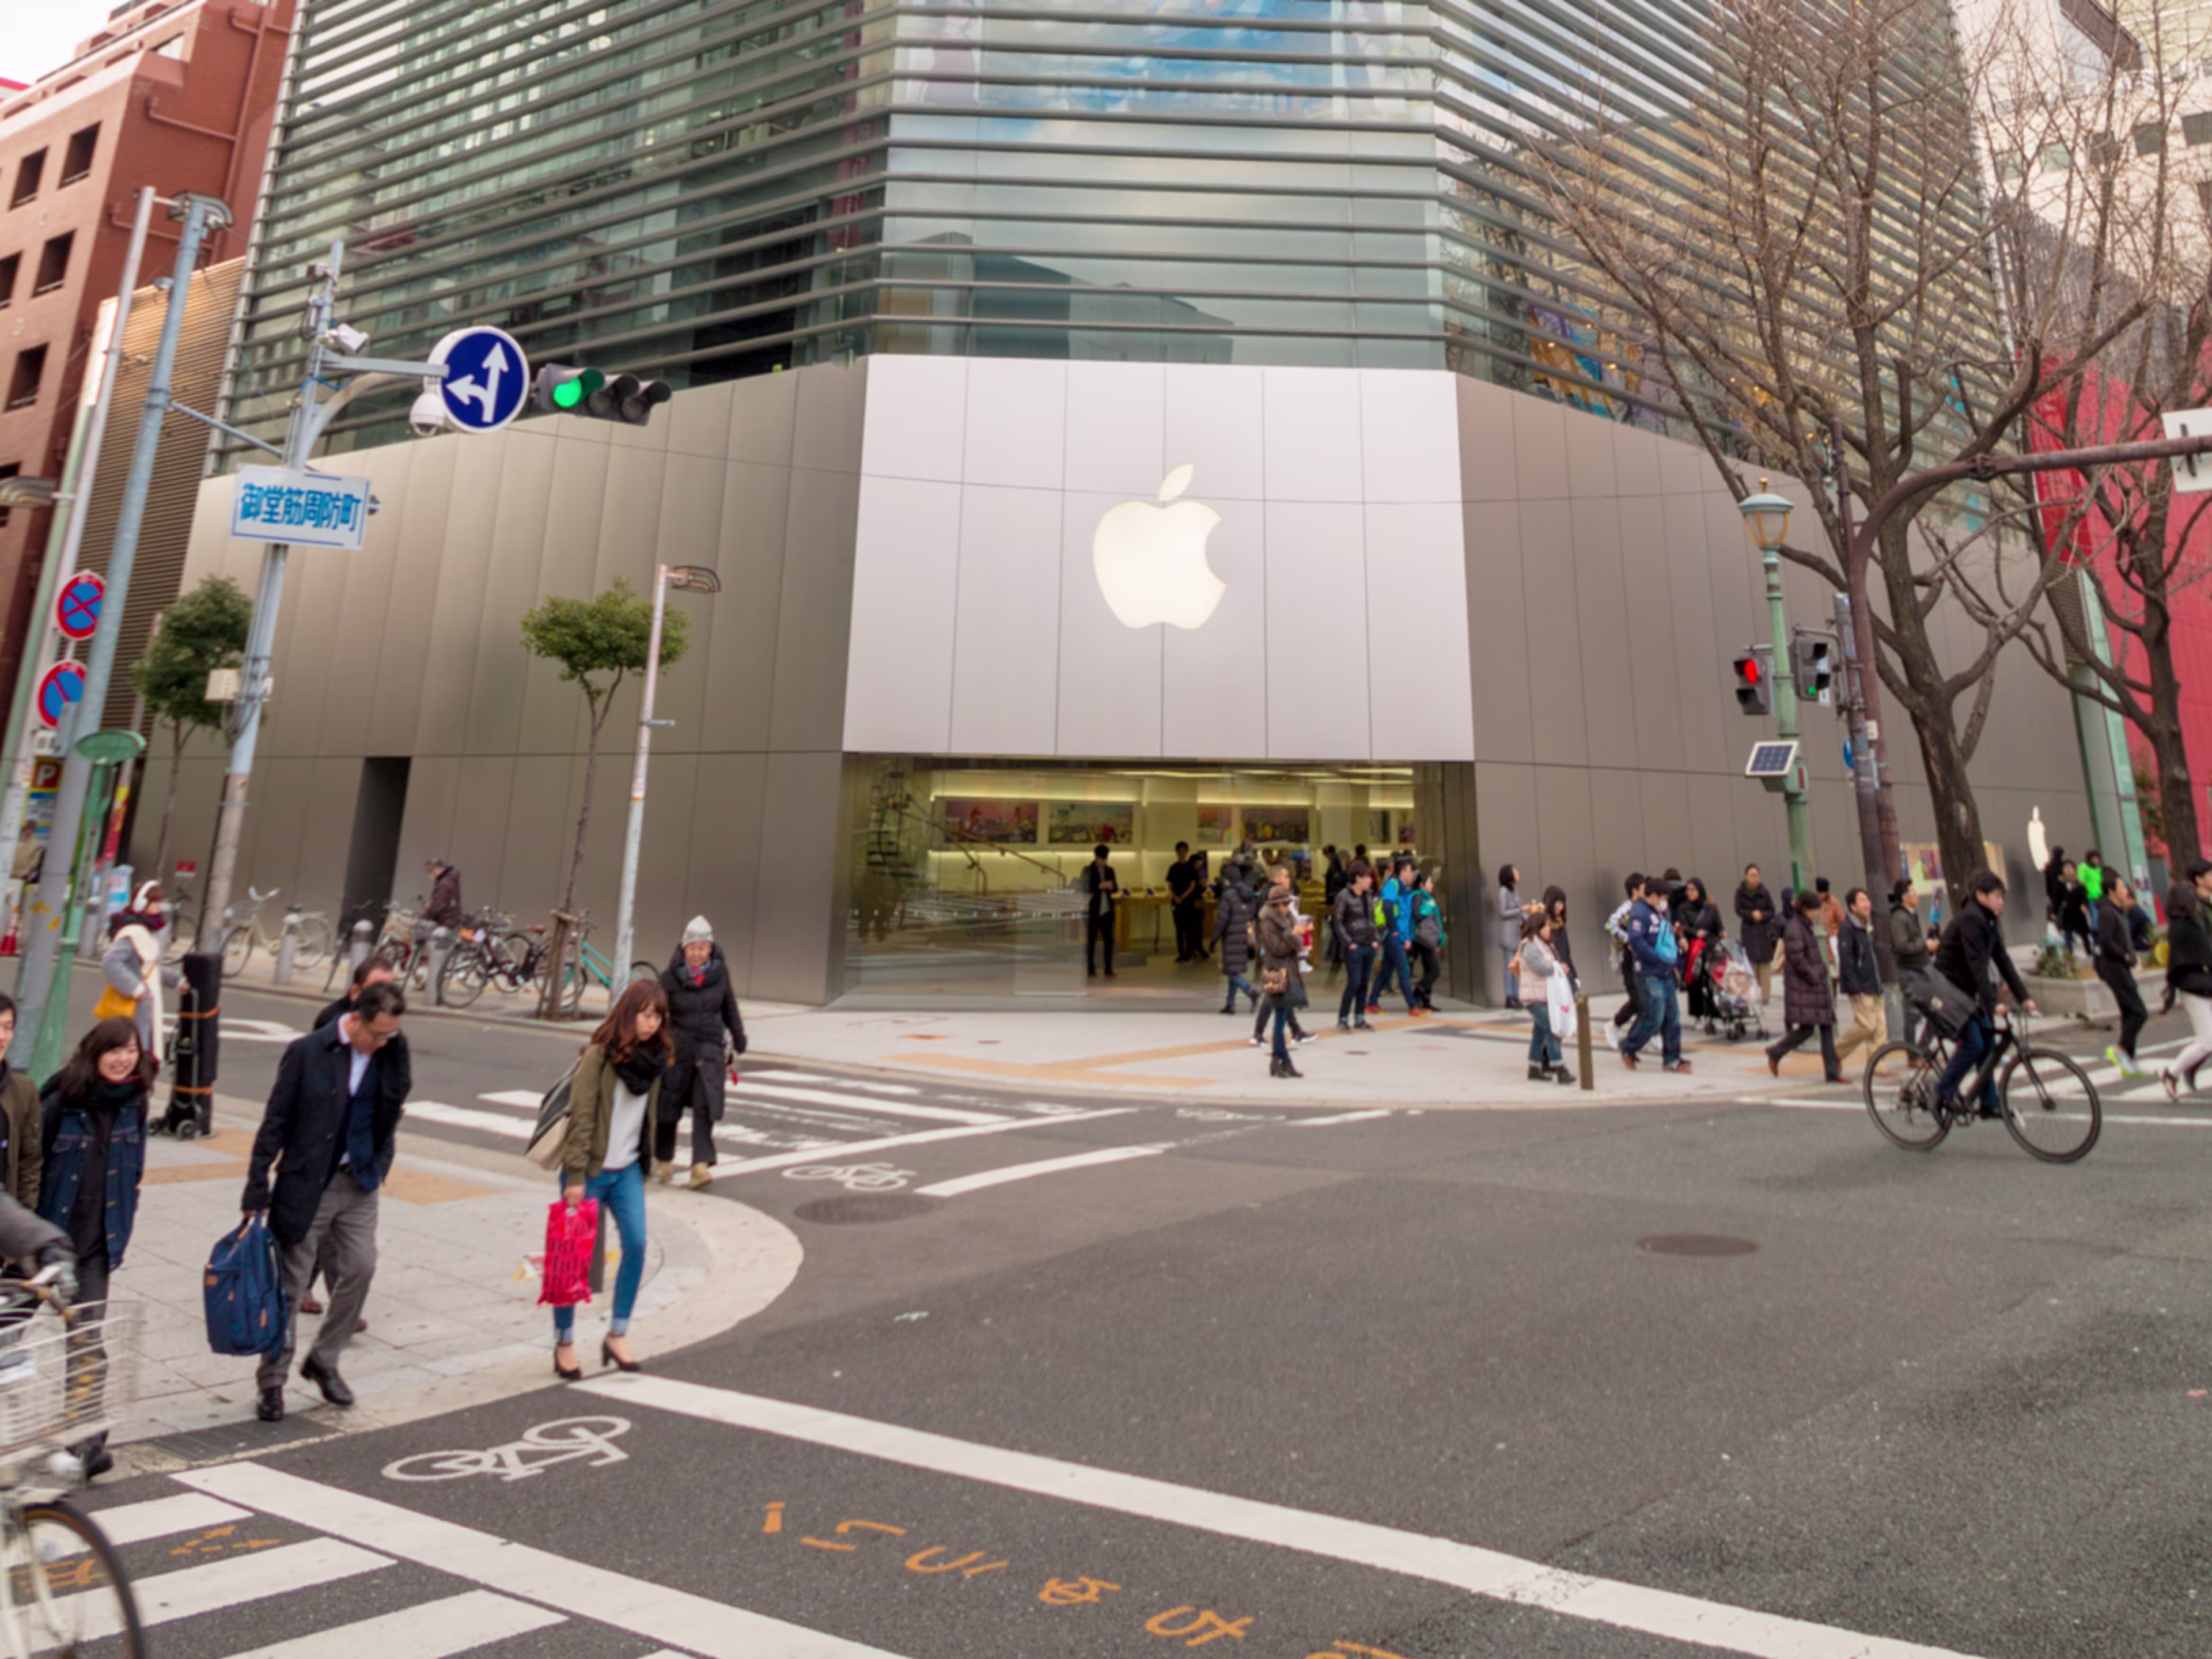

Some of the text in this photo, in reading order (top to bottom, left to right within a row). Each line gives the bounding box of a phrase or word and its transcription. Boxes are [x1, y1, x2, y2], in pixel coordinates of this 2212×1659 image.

[240, 483, 361, 532] 御堂筋周防町
[36, 764, 56, 786] P
